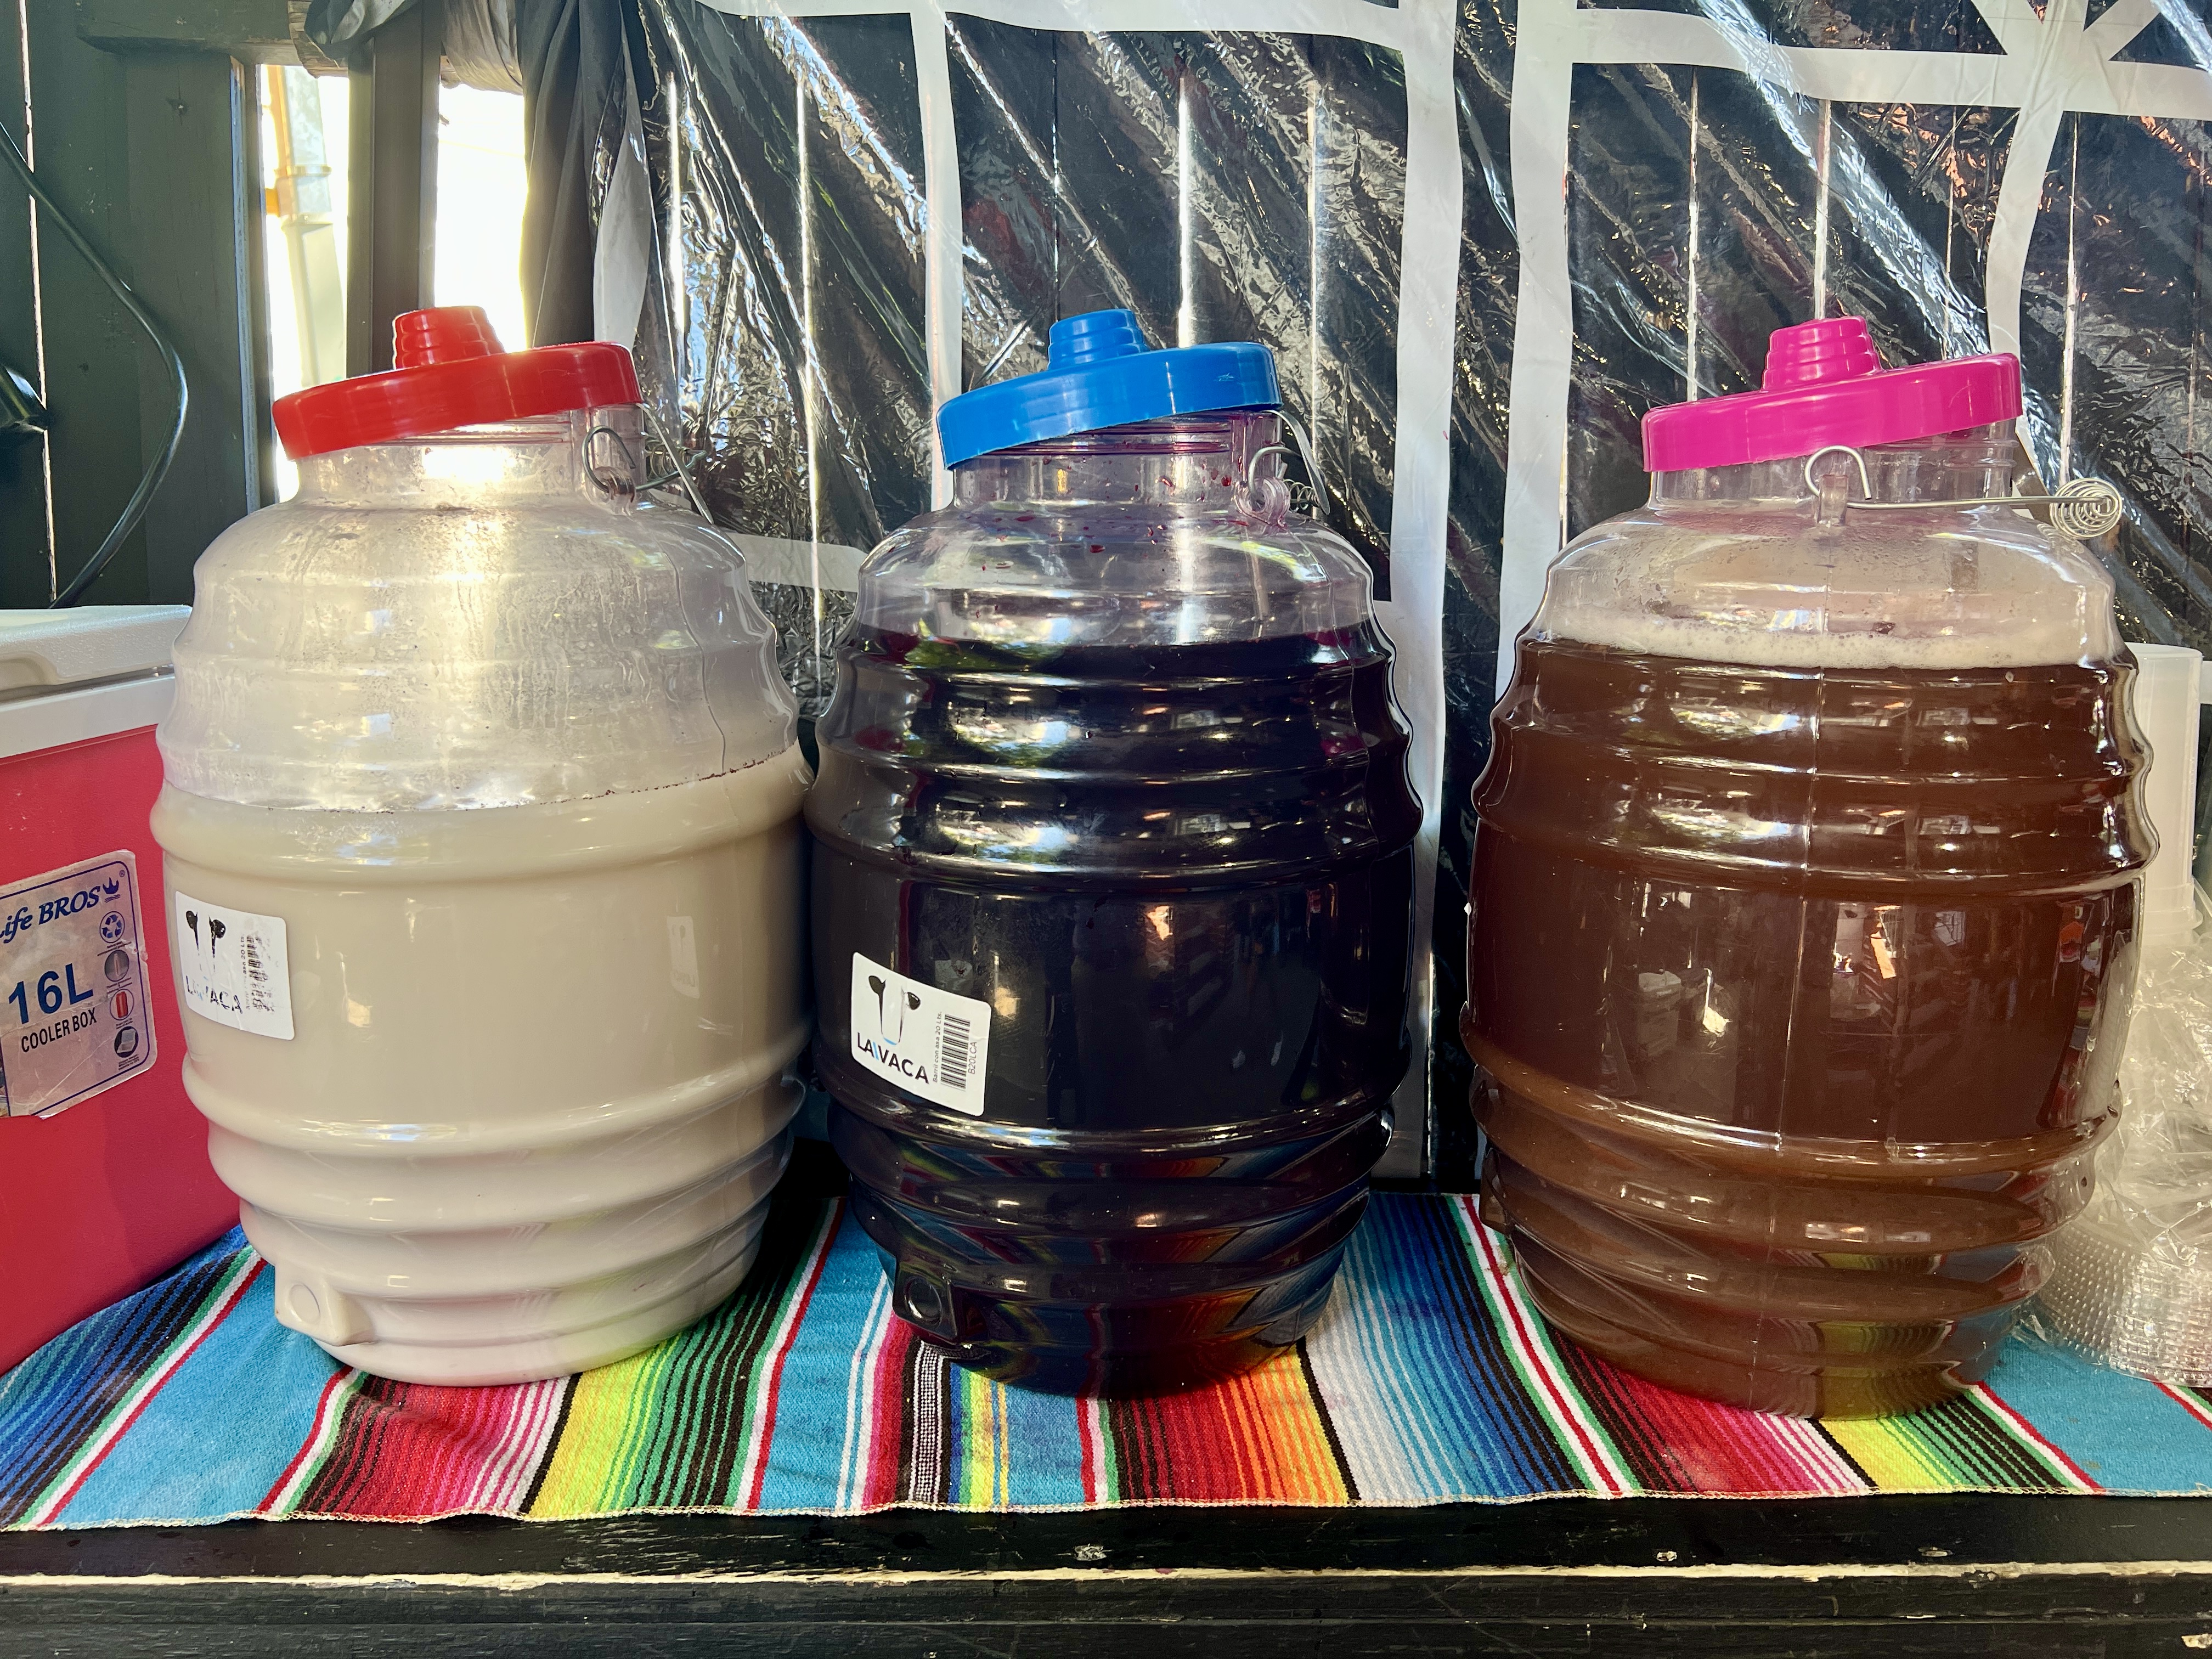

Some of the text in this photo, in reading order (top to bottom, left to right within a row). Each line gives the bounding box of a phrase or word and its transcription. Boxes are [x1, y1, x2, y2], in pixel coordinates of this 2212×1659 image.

[38, 885, 101, 925] BROS
[8, 963, 94, 1025] 16L
[21, 1007, 98, 1053] COOLER BOX
[935, 1025, 941, 1035] 20
[968, 1041, 978, 1075] B20LCA
